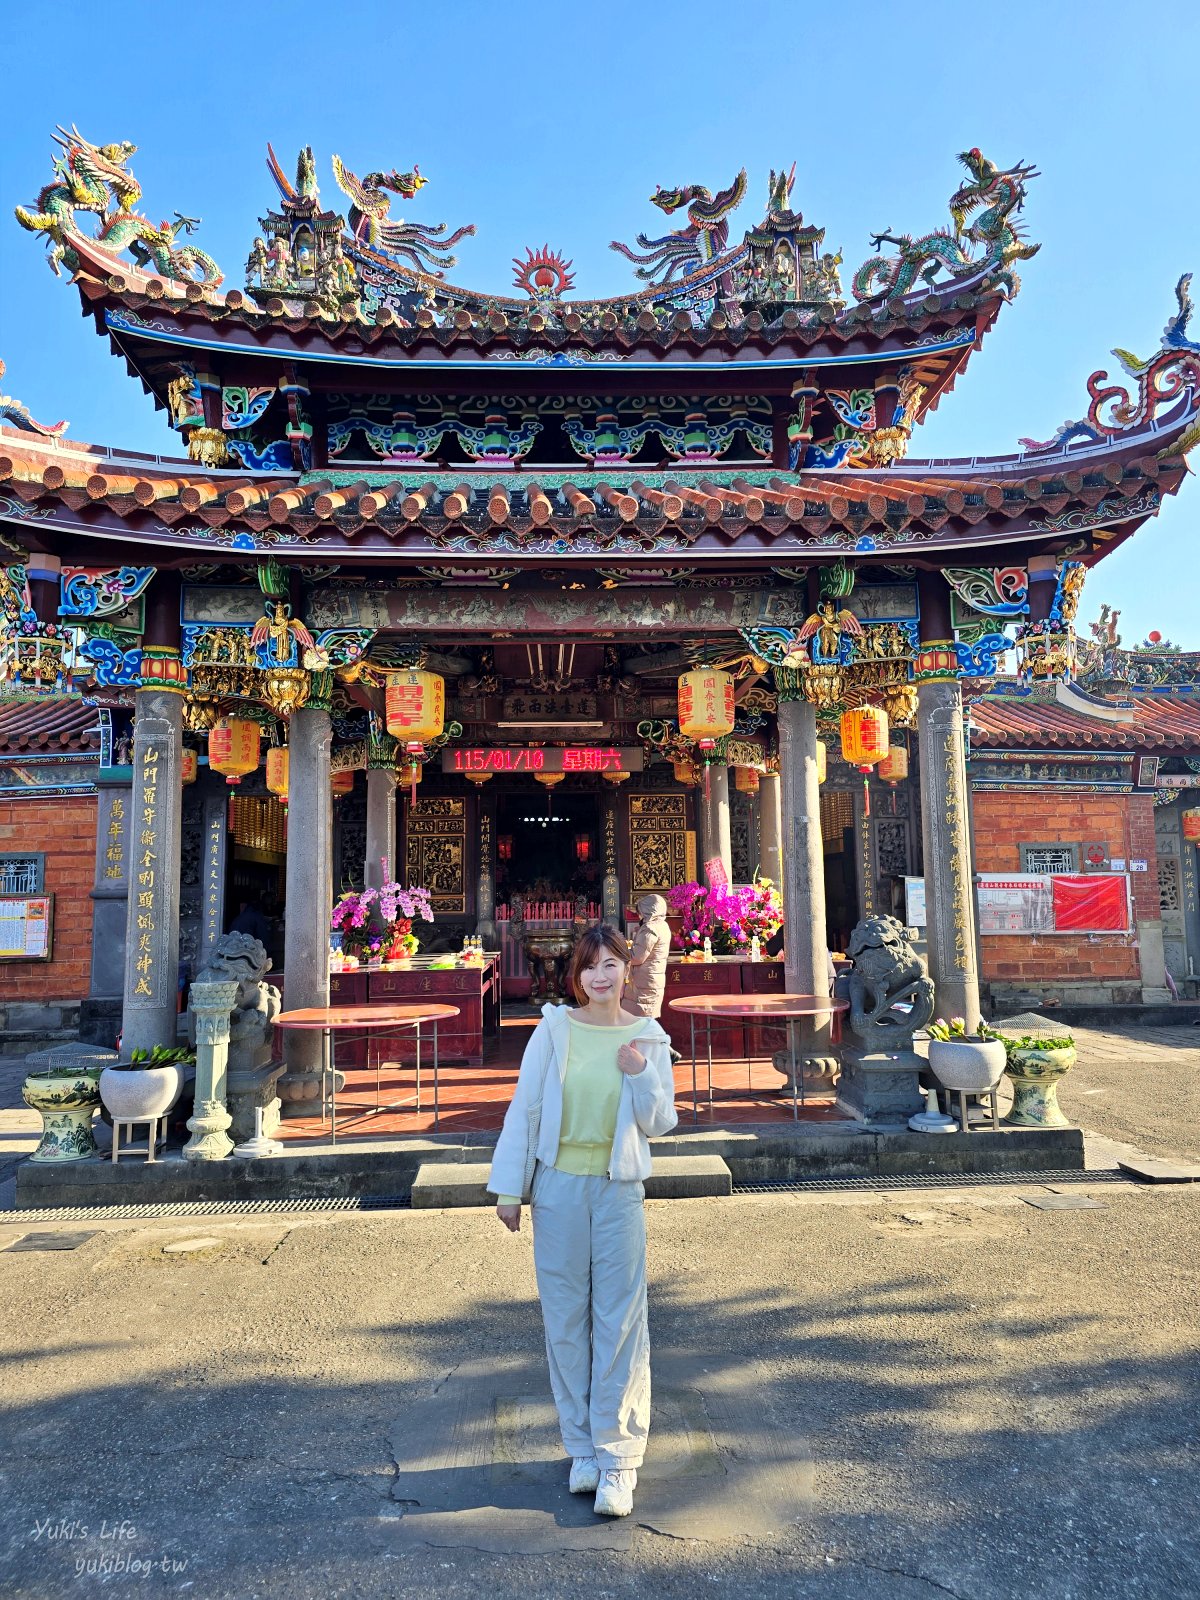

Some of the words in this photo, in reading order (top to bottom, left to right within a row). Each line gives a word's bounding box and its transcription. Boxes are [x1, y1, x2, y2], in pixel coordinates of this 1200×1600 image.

[434, 680, 443, 727] 國泰民安
[703, 677, 717, 725] 國泰民安
[454, 750, 545, 771] 115/01/10
[562, 748, 623, 771] 星期六
[105, 798, 125, 879] 萬年福地
[768, 970, 778, 980] 山
